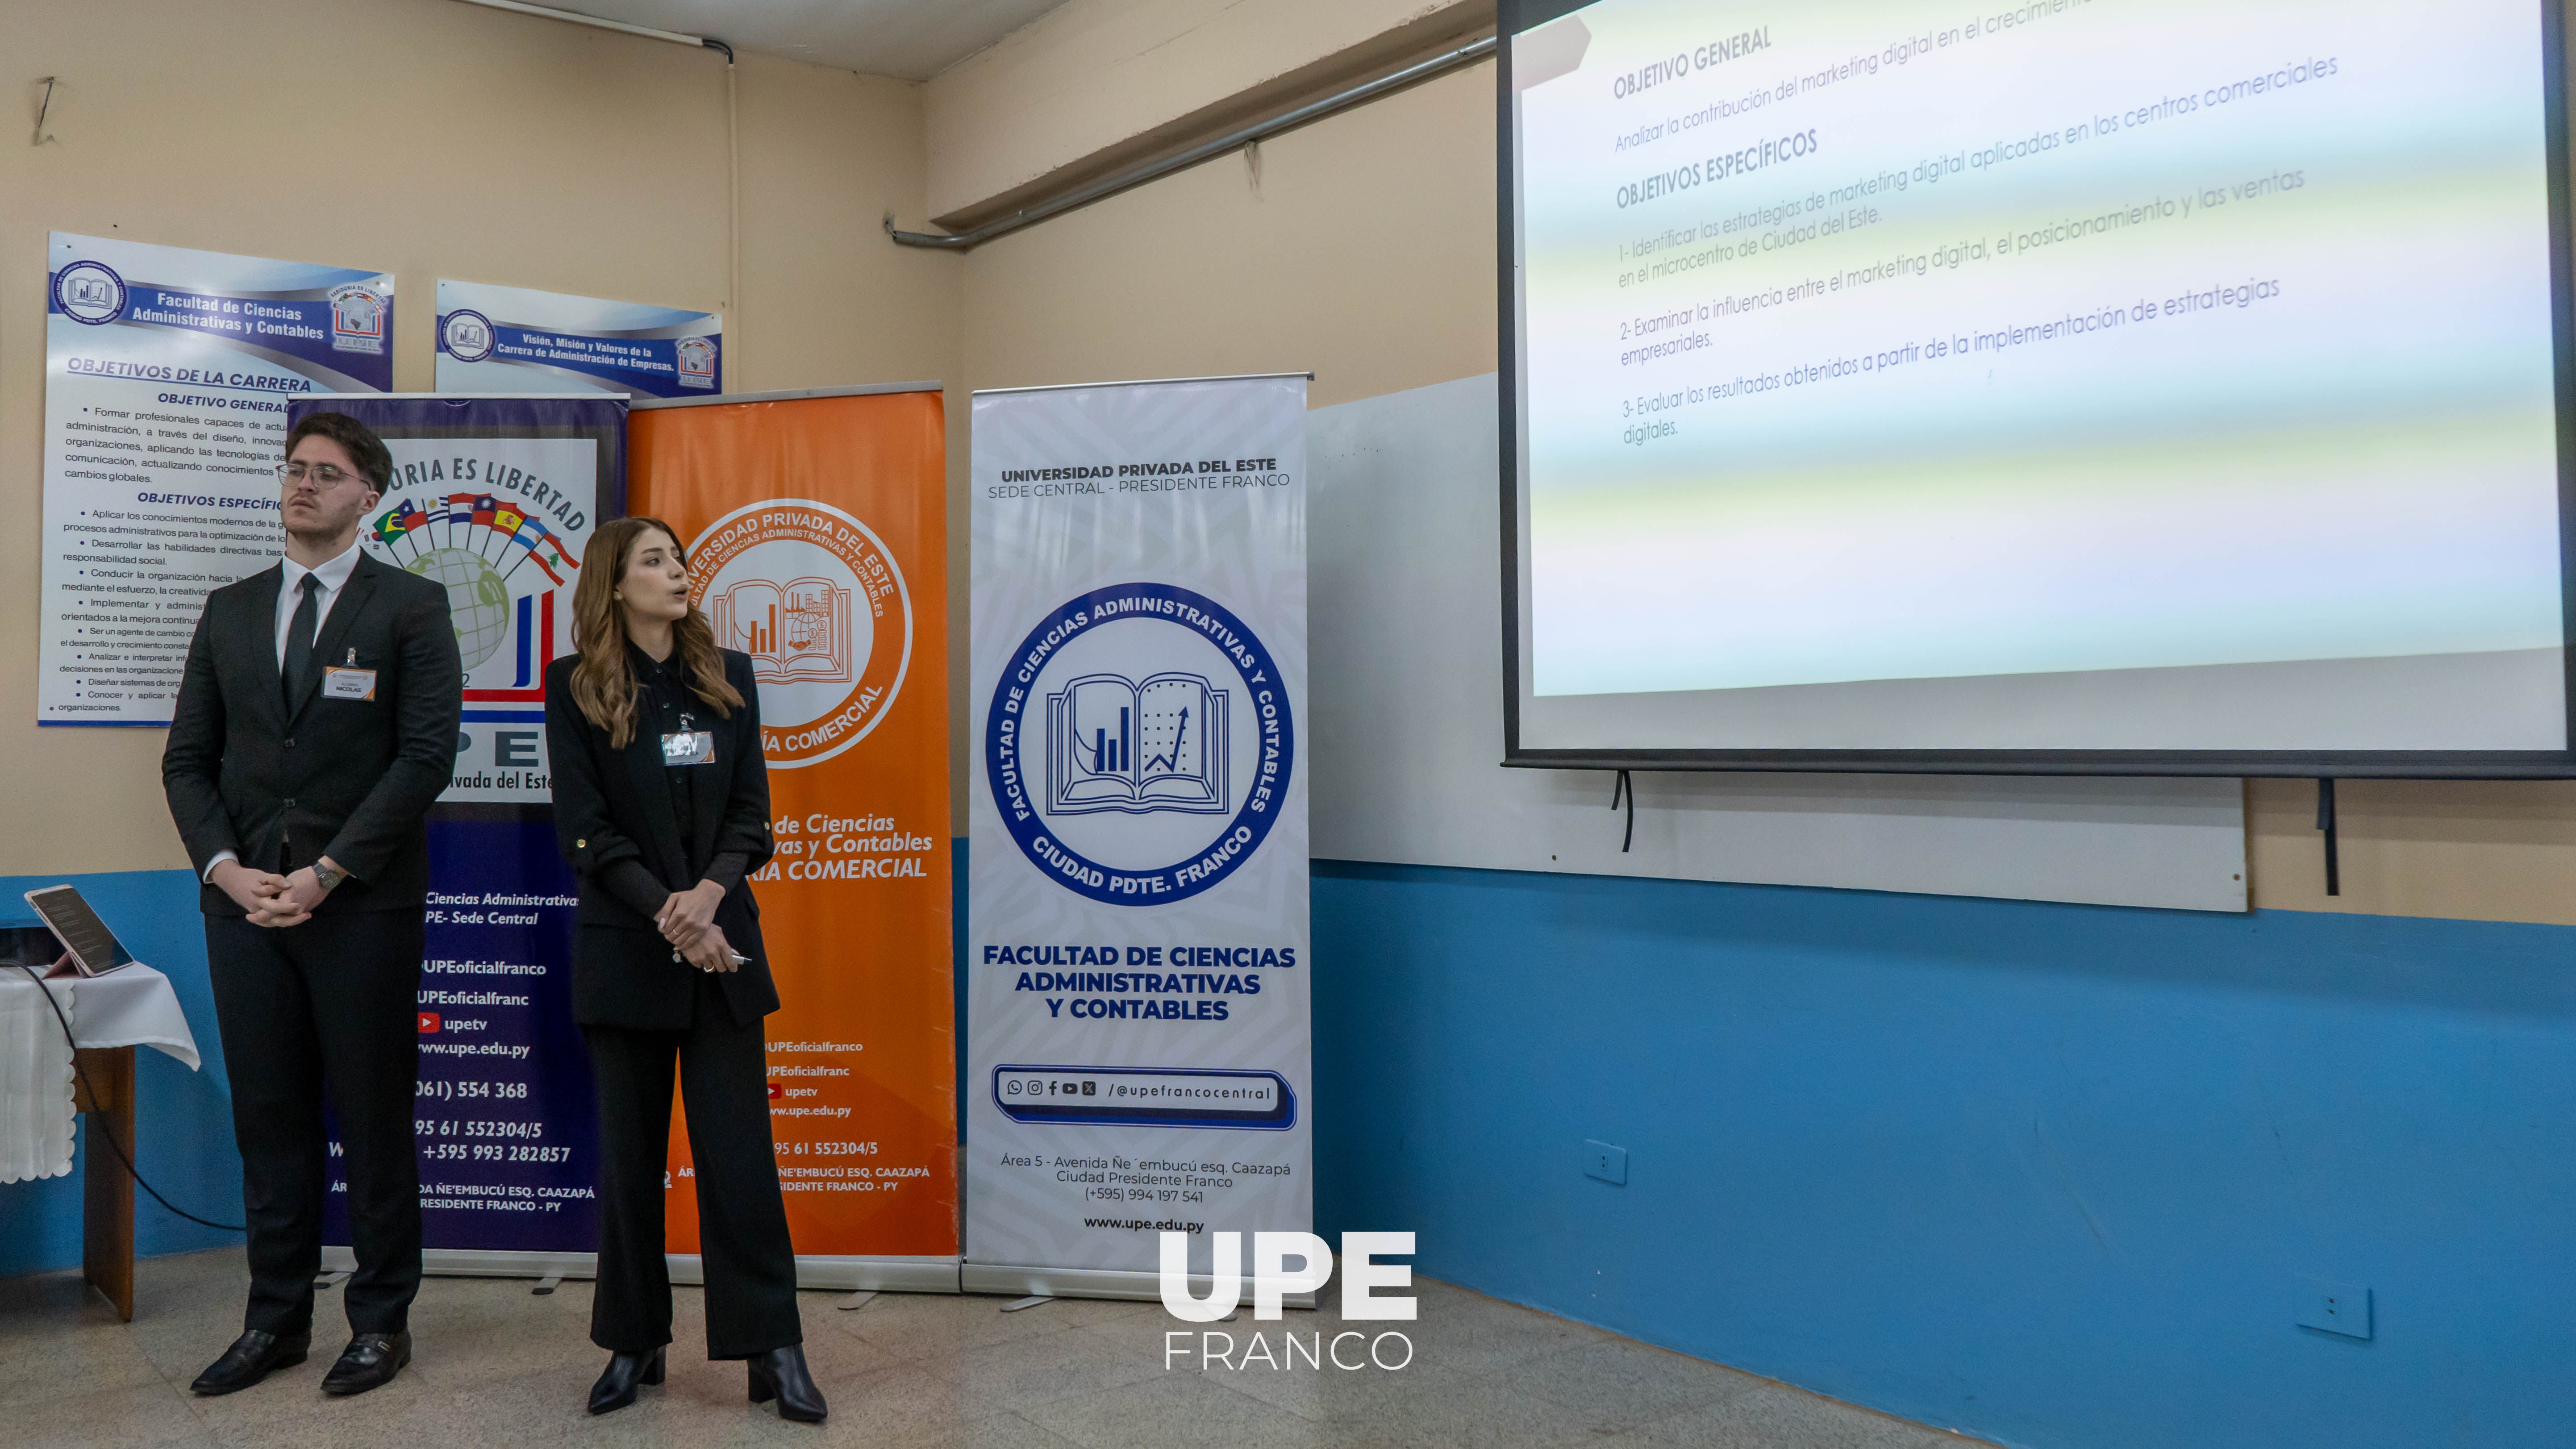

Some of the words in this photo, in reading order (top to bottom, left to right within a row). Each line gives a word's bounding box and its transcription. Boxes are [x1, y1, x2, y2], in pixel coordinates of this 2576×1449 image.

[1614, 53, 1688, 100] OBJETIVO
[1693, 25, 1772, 71] GENERAL
[1616, 162, 1701, 209] OBJETIVOS
[1706, 128, 1818, 182] ESPECÍFICOS
[158, 292, 218, 312] Facultad
[223, 298, 239, 313] de
[244, 302, 302, 321] Ciencias
[133, 308, 241, 330] Administrativas
[246, 321, 253, 334] y
[258, 321, 323, 339] Contables
[522, 334, 553, 347] Visión,
[556, 337, 586, 349] Misión
[589, 343, 594, 353] y
[596, 342, 627, 355] Valores
[630, 346, 641, 356] de
[643, 348, 651, 357] la
[1637, 387, 1684, 415] Evaluar
[1687, 385, 1704, 404] los
[1707, 371, 1780, 400] resultados
[1784, 357, 1858, 387] obtenidos
[1863, 355, 1872, 371] a
[1877, 341, 1920, 373] partir
[1925, 337, 1948, 359] de
[1953, 334, 1968, 354] la
[1974, 305, 2125, 353] implementación
[2131, 299, 2157, 323] de
[2164, 277, 2280, 316] estrategias
[498, 343, 533, 356] Carrera
[535, 348, 546, 358] de
[549, 350, 615, 365] Administración
[617, 357, 629, 366] de
[630, 358, 674, 372] Empresas.
[67, 358, 172, 379] OBJETIVOS
[177, 367, 200, 382] DE
[204, 370, 225, 384] LA
[230, 373, 311, 392] CARRERA
[158, 392, 226, 408] OBJETIVO
[95, 407, 130, 418] Formar
[135, 411, 200, 425] profesionales
[204, 417, 244, 429] capaces
[249, 421, 260, 429] de
[66, 422, 141, 435] administración,
[158, 429, 187, 439] través
[193, 431, 207, 441] del
[213, 433, 246, 445] diseño,
[1623, 418, 1679, 447] digitales.
[1002, 466, 1114, 482] UNIVERSIDAD
[1118, 462, 1194, 477] PRIVADA
[1198, 459, 1231, 473] DEL
[1236, 458, 1276, 471] ESTE
[453, 458, 477, 479] ES
[485, 462, 585, 532] LIBERTAD
[988, 484, 1029, 499] SEDE
[1034, 481, 1105, 496] CENTRAL
[1119, 477, 1217, 493] PRESIDENTE
[1222, 474, 1290, 489] FRANCO
[138, 492, 215, 507] OBJETIVOS
[219, 497, 281, 510] ESPECÍFI
[92, 539, 142, 550] Desarrollar
[147, 542, 160, 550] las
[165, 543, 216, 554] habilidades
[220, 546, 262, 555] directivas
[688, 518, 759, 589] IVERSIDAD
[763, 512, 833, 535] PRIVADA
[836, 523, 864, 556] DEL
[863, 553, 894, 597] ESTE
[63, 553, 137, 564] responsabilidad
[138, 557, 167, 566] social.
[692, 575, 709, 606] ULTAD
[706, 561, 719, 575] DE
[718, 533, 759, 562] CIENCIAS
[762, 529, 846, 555] ADMINISTRATIVAS
[846, 553, 854, 561] Y
[852, 560, 884, 618] CONTABLES
[1094, 597, 1255, 669] ADMINISTRATIVAS
[1018, 612, 1088, 683] CIENCIAS
[1251, 670, 1265, 685] Y
[1005, 686, 1023, 714] DE
[784, 686, 883, 751] COMERCIAL
[1251, 690, 1279, 812] CONTABLES
[496, 771, 519, 789] del
[1000, 720, 1030, 821] FACULTAD
[774, 814, 799, 833] de
[806, 813, 894, 833] Ciencias
[809, 841, 820, 859] y
[826, 832, 932, 853] Contables
[788, 858, 927, 881] COMERCIAL
[1033, 836, 1104, 888] CIUDAD
[1109, 875, 1171, 895] PDTE.
[1175, 825, 1251, 889] FRANCO
[425, 891, 479, 906] Ciencias
[425, 911, 448, 924] PE-
[452, 912, 484, 924] Sede
[488, 912, 538, 925] Central
[421, 960, 546, 975] UPEoficialfranco
[984, 945, 1119, 966] FACULTAD
[1127, 946, 1162, 966] DE
[1169, 947, 1296, 968] CIENCIAS
[1015, 972, 1261, 994] ADMINISTRATIVAS
[1046, 999, 1063, 1018] Y
[1070, 999, 1229, 1020] CONTABLES
[445, 1020, 487, 1032] upetv
[458, 1082, 489, 1098] 554
[496, 1083, 527, 1098] 368
[785, 1086, 817, 1099] upetv
[1108, 1083, 1271, 1100] /@upefrancocentral
[440, 1120, 458, 1136] 61
[465, 1121, 542, 1139] 552304/5
[423, 1145, 467, 1160] +595
[474, 1145, 503, 1161] 993
[509, 1145, 571, 1162] 282857
[794, 1142, 809, 1155] 61
[815, 1142, 878, 1155] 552304/5
[848, 1167, 872, 1178] ESQ.
[875, 1165, 930, 1178] CAAZAPÁ
[1000, 1153, 1032, 1167] Área
[1035, 1155, 1042, 1167] 5
[1054, 1157, 1108, 1170] Avenida
[1200, 1162, 1228, 1175] esq.
[1232, 1162, 1291, 1176] Caazapá
[826, 1182, 874, 1191] FRANCO
[884, 1182, 898, 1192] PY
[1056, 1170, 1105, 1185] Ciudad
[1109, 1171, 1182, 1187] Presidente
[1185, 1174, 1233, 1189] Franco
[509, 1186, 534, 1198] ESQ.
[538, 1187, 595, 1199] CAAZAPÁ
[1085, 1187, 1125, 1203] (+595)
[1129, 1188, 1155, 1202] 994
[1157, 1189, 1179, 1203] 197
[1182, 1191, 1204, 1203] 541
[421, 1199, 484, 1210] RESIDENTE
[487, 1200, 536, 1212] FRANCO
[546, 1202, 561, 1212] PY
[1084, 1216, 1204, 1234] www.upe.edu.py
